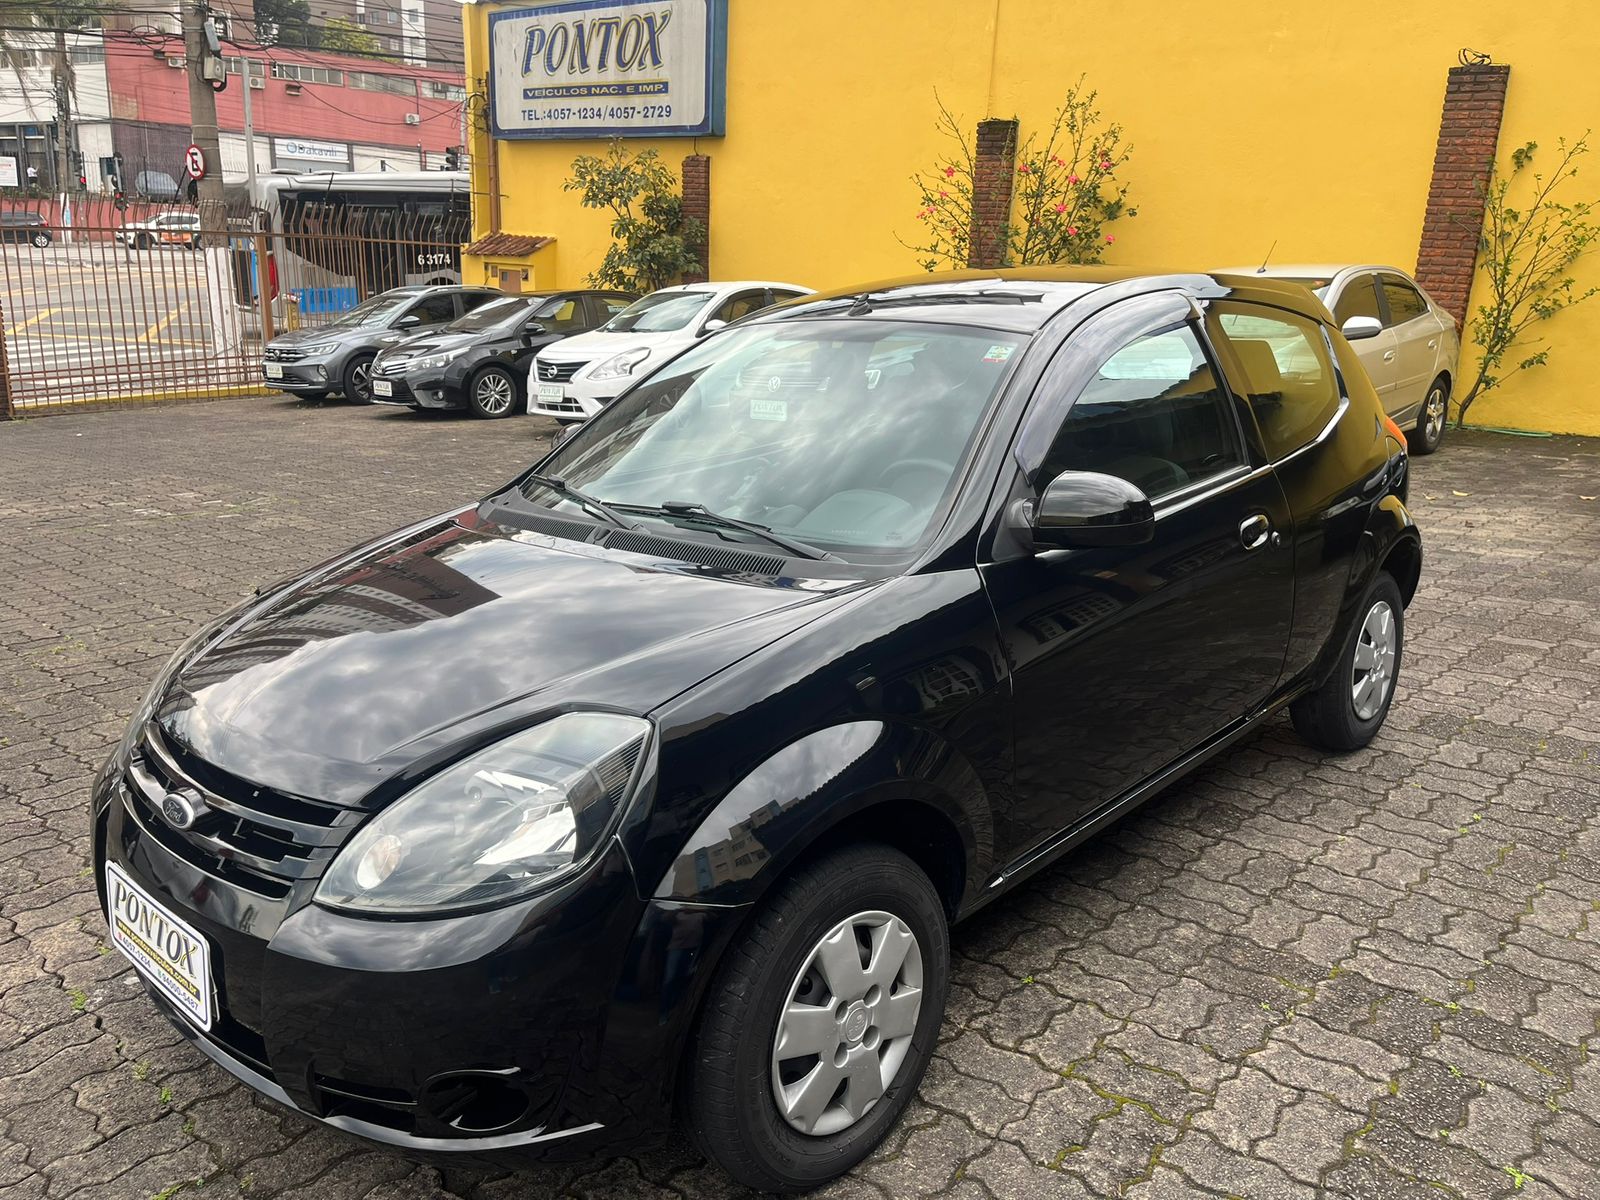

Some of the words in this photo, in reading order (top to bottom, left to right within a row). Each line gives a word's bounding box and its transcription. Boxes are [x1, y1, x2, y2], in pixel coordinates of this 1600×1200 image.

[521, 10, 673, 77] PONTOX
[591, 85, 622, 94] NAC.
[639, 84, 665, 92] IMP.
[417, 254, 425, 265] 6
[426, 253, 451, 265] 3174
[165, 800, 183, 822] Ford
[113, 881, 197, 979] PONTOX
